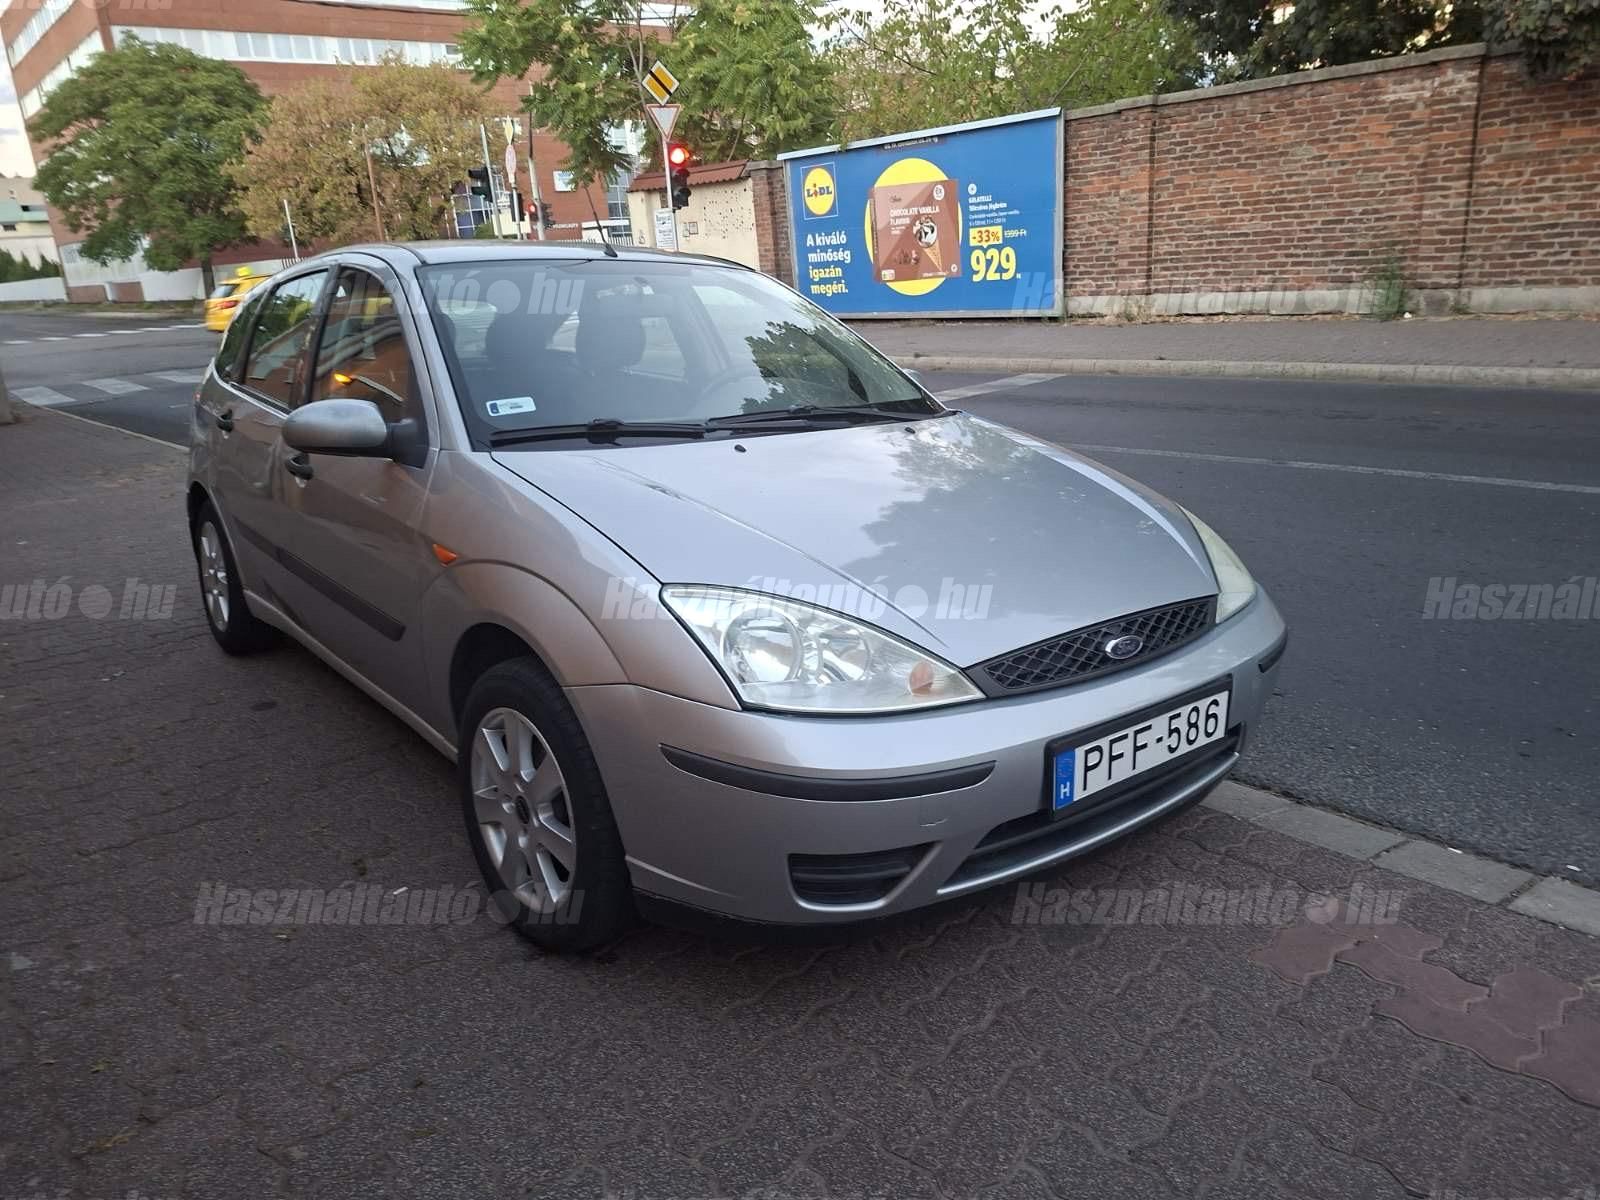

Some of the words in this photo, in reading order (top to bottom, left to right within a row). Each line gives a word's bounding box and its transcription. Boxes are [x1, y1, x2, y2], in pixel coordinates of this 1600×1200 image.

[806, 233, 814, 247] A
[816, 230, 847, 246] kiváló
[972, 229, 1000, 243] -33%
[808, 248, 851, 264] minőség
[971, 247, 1016, 282] 929
[809, 265, 842, 281] igazán
[810, 280, 849, 297] megéri.
[1083, 698, 1220, 791] PFF-586
[1060, 782, 1070, 799] H
